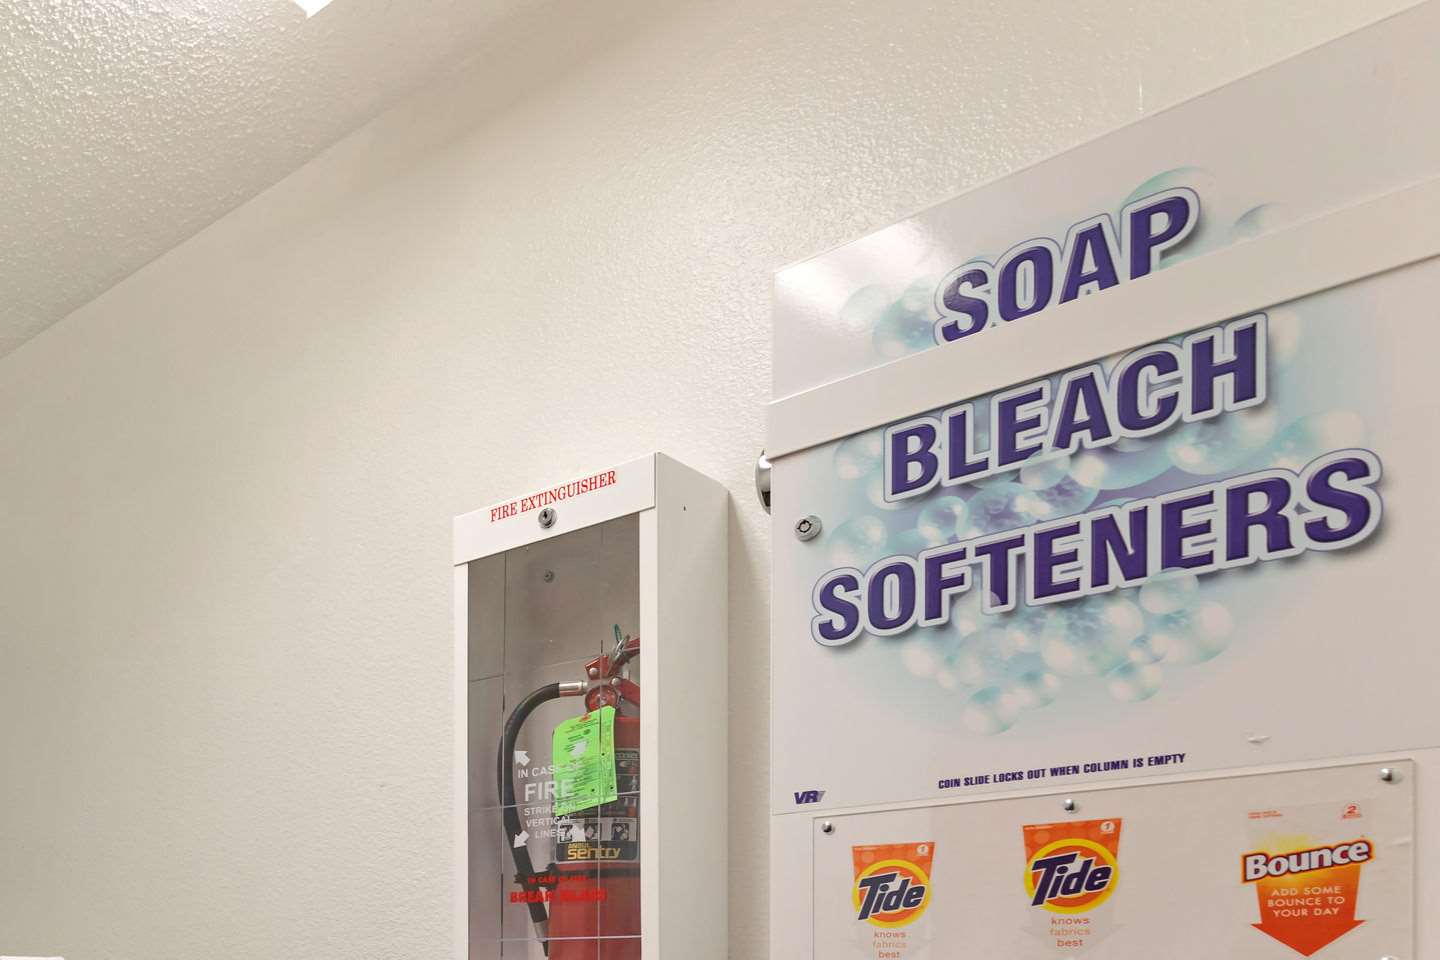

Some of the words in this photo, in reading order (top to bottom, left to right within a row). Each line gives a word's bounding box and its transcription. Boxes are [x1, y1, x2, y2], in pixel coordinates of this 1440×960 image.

[938, 192, 1194, 343] SOAP
[888, 318, 1261, 497] BLEACH
[490, 501, 518, 522] FIRE
[520, 470, 617, 513] EXTINGUISHER
[816, 454, 1372, 642] SOFTENERS
[517, 768, 529, 779] IN
[938, 778, 961, 789] COIN
[964, 774, 990, 786] SLIDE
[993, 771, 1024, 783] LOCKS
[1027, 768, 1046, 780] OUT
[1050, 765, 1080, 777] WHEN
[1083, 759, 1129, 773] COLUMN
[1132, 758, 1144, 768] IS
[1147, 753, 1186, 767] EMPTY
[524, 778, 576, 802] FIRE
[524, 806, 558, 816] STRIKE
[567, 847, 621, 860] sentry
[1245, 840, 1369, 881] Bounce
[1031, 852, 1112, 907] Tide
[857, 872, 926, 921] Tide
[1271, 887, 1298, 897] ADD
[1303, 886, 1342, 896] SOME
[1267, 897, 1322, 908] BOUNCE
[1327, 896, 1345, 905] TO
[1272, 908, 1309, 918] YOUR
[1313, 907, 1340, 916] DAY
[1051, 916, 1090, 925] knows
[874, 930, 907, 938] knows
[1050, 927, 1091, 936] fabrics
[1056, 939, 1083, 947] best
[878, 951, 901, 959] best
